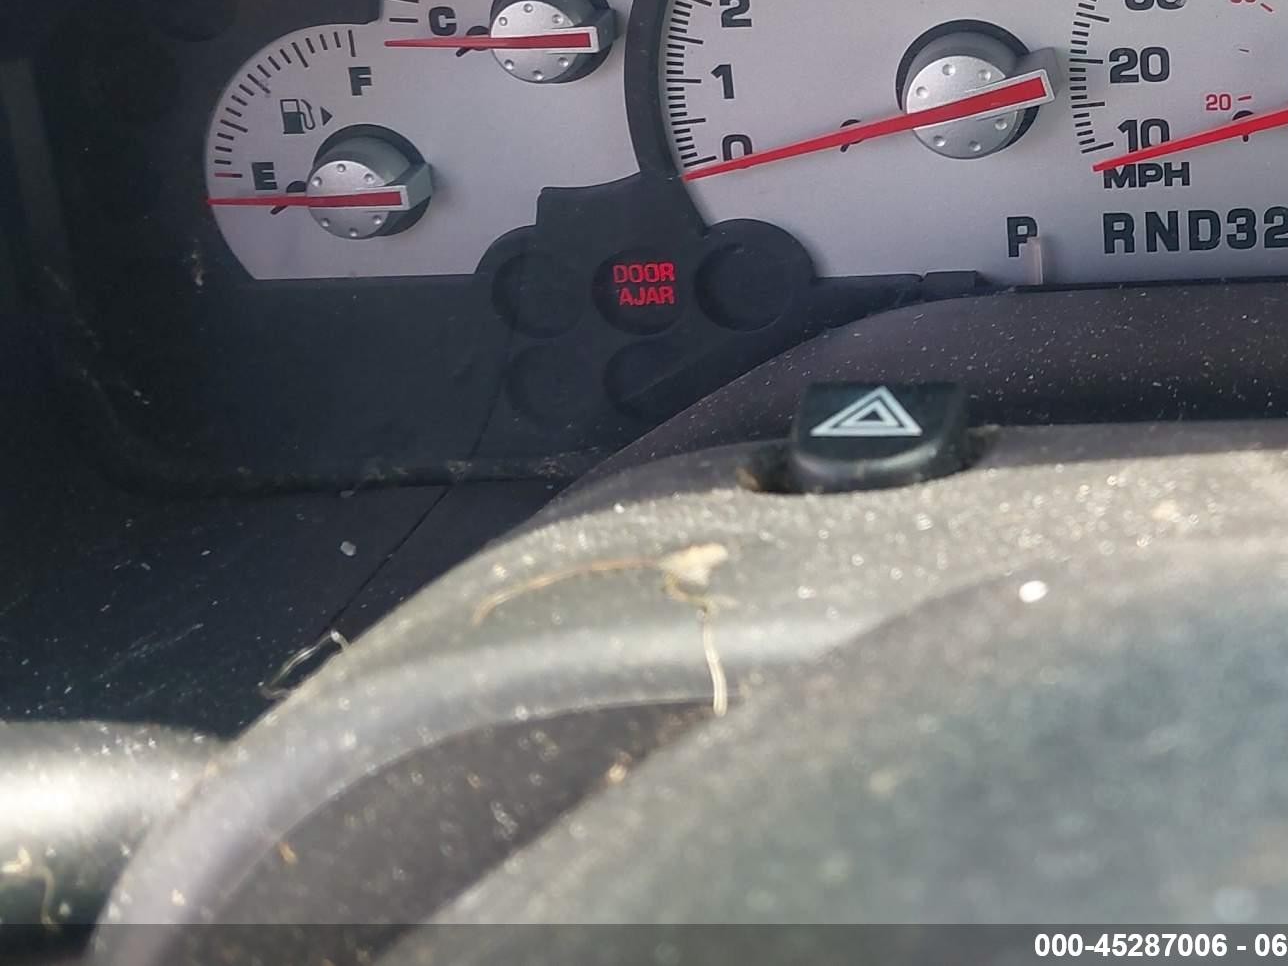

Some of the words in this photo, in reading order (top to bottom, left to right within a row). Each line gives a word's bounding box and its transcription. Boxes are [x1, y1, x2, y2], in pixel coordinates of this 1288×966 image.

[427, 6, 458, 36] C
[1108, 46, 1170, 84] 20
[347, 66, 373, 96] F
[710, 63, 735, 100] 1
[1205, 93, 1232, 111] 20
[722, 134, 753, 164] 0
[1118, 119, 1170, 153] 10
[251, 161, 279, 191] E
[1104, 162, 1190, 189] MPH
[1006, 216, 1038, 258] P
[613, 263, 675, 282] DOOR
[619, 286, 675, 305] AJAR
